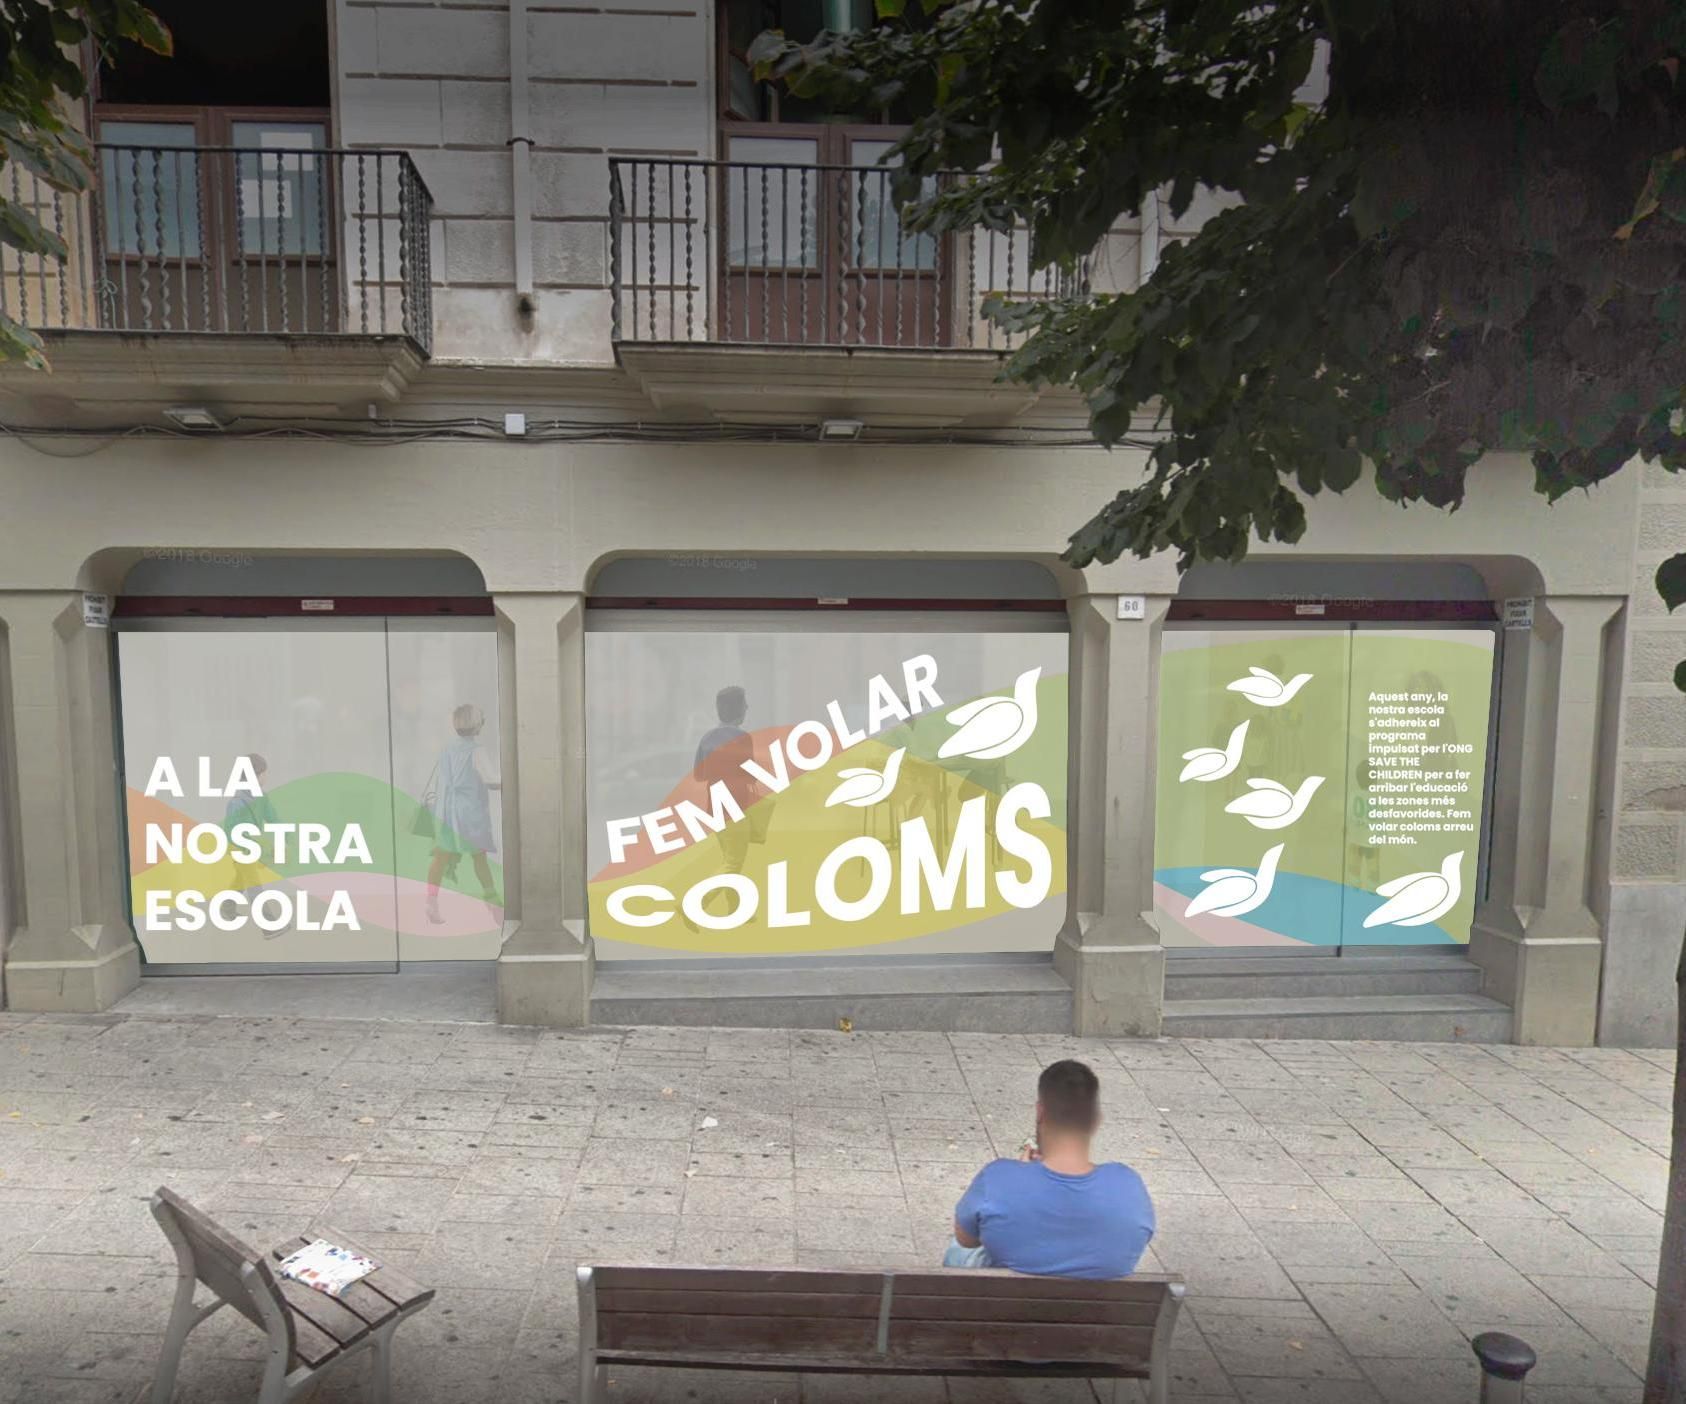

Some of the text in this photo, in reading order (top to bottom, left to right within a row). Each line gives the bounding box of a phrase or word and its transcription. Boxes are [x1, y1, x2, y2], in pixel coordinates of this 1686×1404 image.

[1124, 600, 1139, 611] 60
[1368, 691, 1449, 704] Aquest any, la
[1368, 704, 1445, 715] nostra escola
[1428, 717, 1440, 728] al
[1368, 732, 1426, 743] programa
[1368, 744, 1420, 755] impulsat
[1420, 745, 1441, 756] per
[606, 654, 944, 863] FEM VOLAR
[1368, 756, 1420, 767] SAVE THE
[144, 756, 264, 797] A LA
[1368, 769, 1471, 782] CHILDREN per a fer
[1368, 782, 1409, 793] arribar
[1368, 795, 1456, 806] a les zones més
[1368, 807, 1472, 819] desfavorides. Fem
[1368, 821, 1474, 832] volar coloms arreu
[145, 822, 373, 864] NOSTRA
[1368, 834, 1387, 845] del
[606, 782, 1052, 930] COLOMS
[145, 889, 361, 931] ESCOLA
